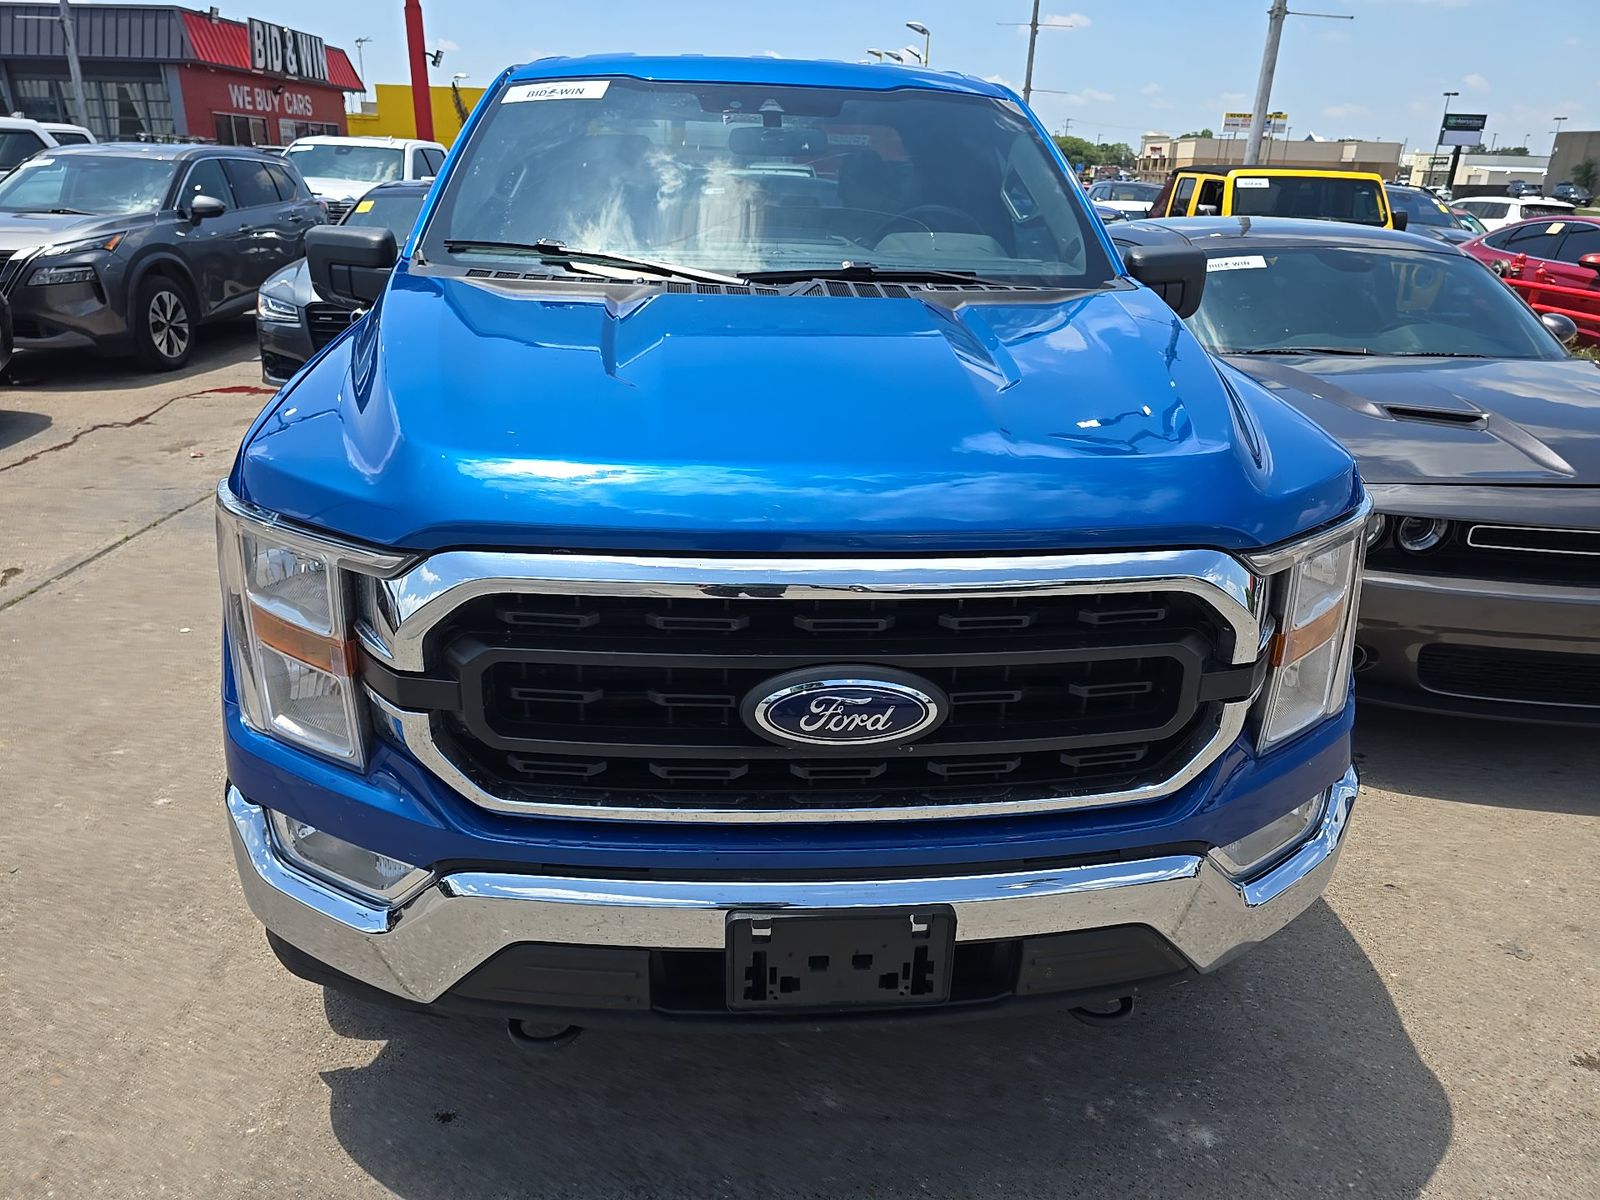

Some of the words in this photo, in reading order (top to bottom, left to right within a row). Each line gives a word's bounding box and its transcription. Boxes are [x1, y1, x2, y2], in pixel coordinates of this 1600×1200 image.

[253, 20, 283, 72] BID
[285, 29, 299, 76] &
[297, 33, 329, 82] WIN
[228, 84, 253, 110] WE
[254, 87, 283, 112] BUY
[284, 92, 313, 116] CARS
[526, 89, 546, 98] BID
[560, 87, 585, 95] WIN
[799, 696, 896, 732] Ford
